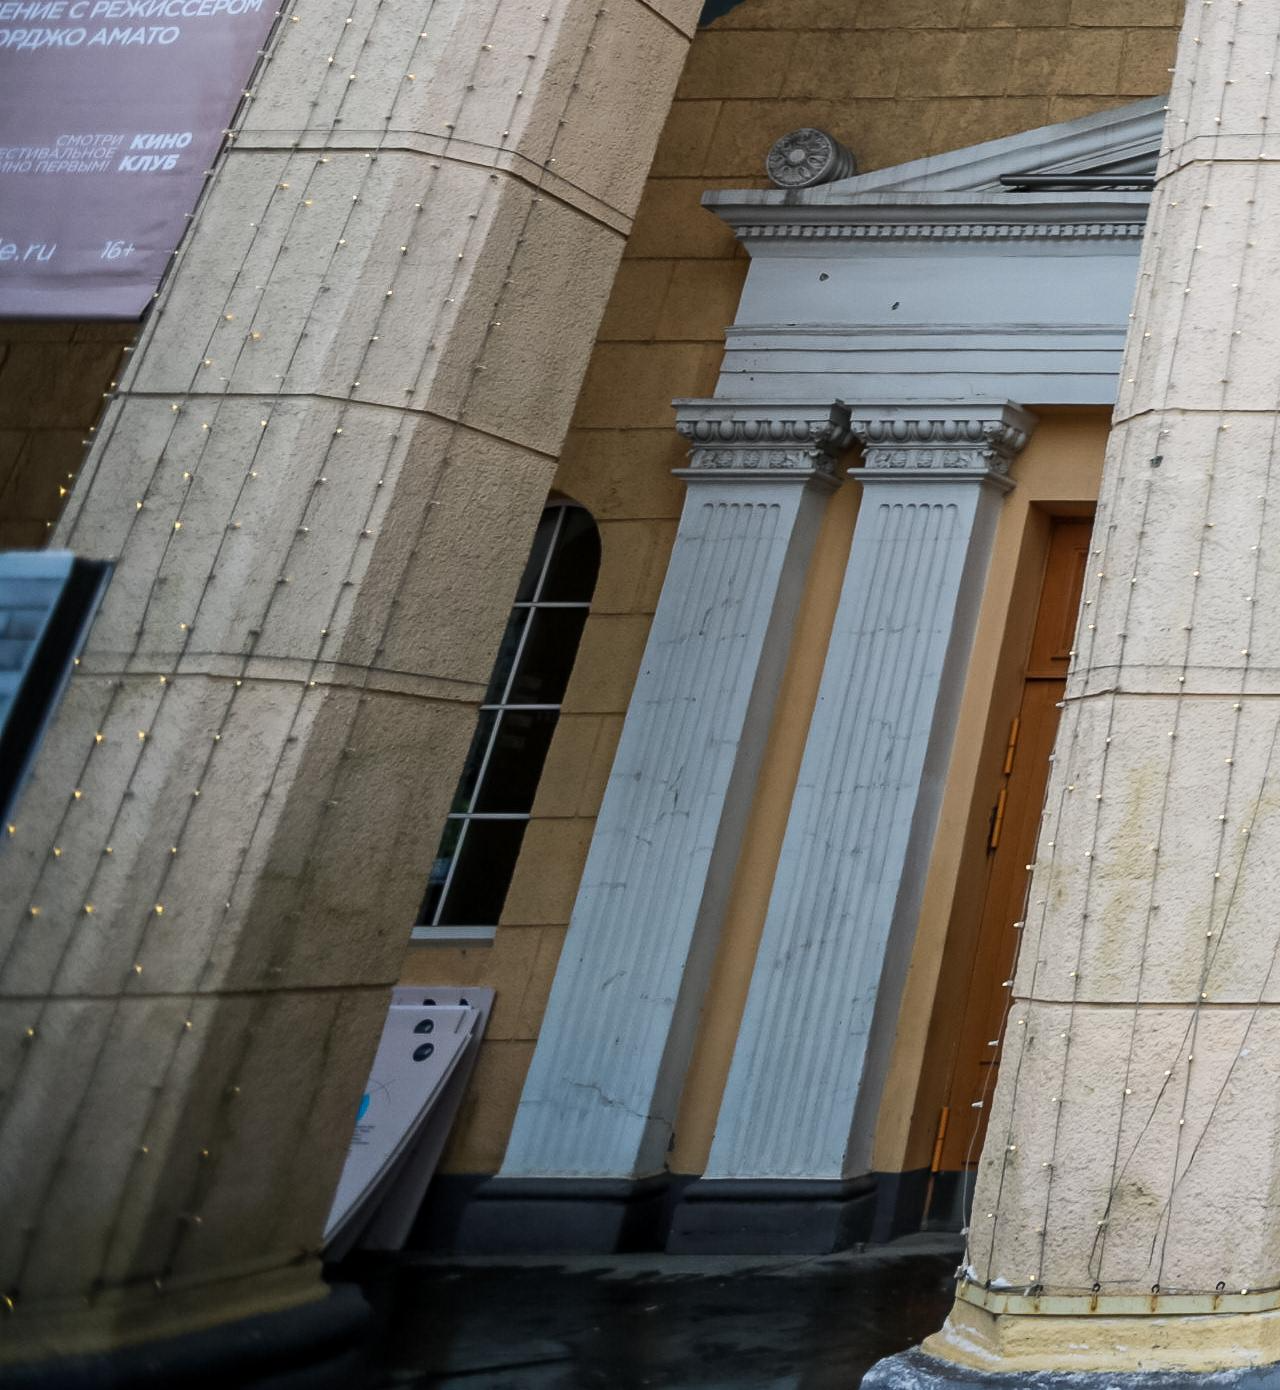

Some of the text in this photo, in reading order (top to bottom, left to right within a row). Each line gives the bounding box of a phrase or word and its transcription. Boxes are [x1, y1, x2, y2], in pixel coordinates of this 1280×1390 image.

[69, 1, 90, 19] С
[90, 0, 263, 18] РЕЖИССЕРОМ
[87, 26, 180, 45] АМАТО
[56, 134, 124, 147] СМОТРИ
[130, 132, 192, 149] КИНО
[118, 154, 180, 171] КЛУБ
[0, 237, 135, 261] e.ru 16+
